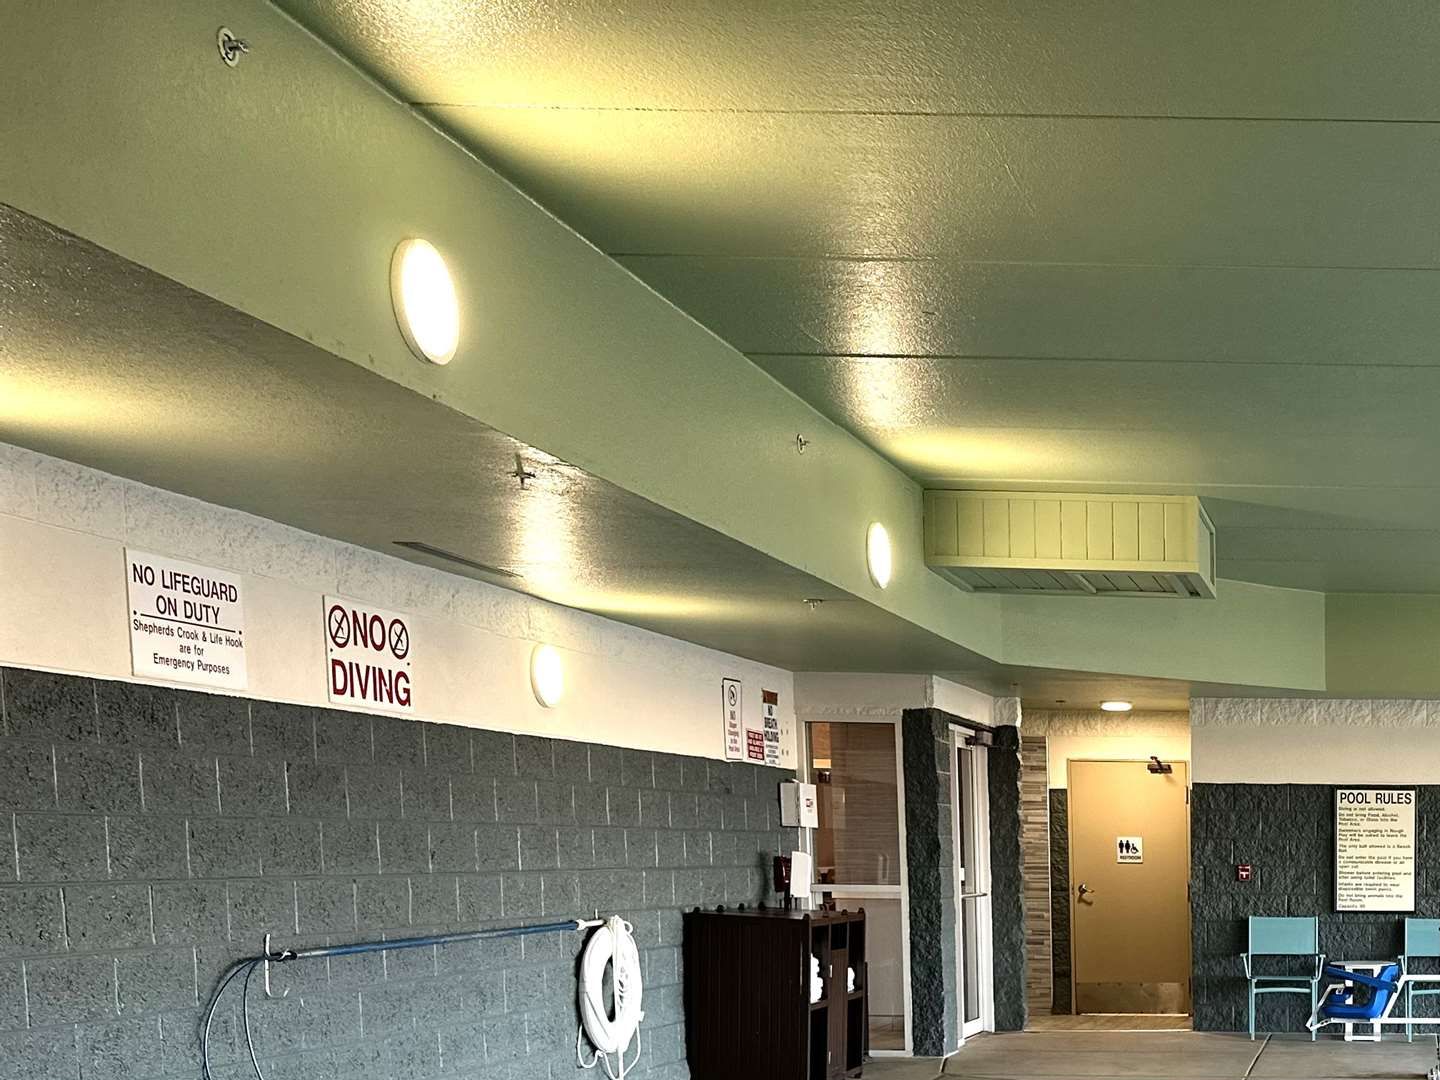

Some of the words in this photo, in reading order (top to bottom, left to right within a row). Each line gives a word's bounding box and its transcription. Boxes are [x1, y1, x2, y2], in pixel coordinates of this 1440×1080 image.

[132, 563, 155, 586] NO
[161, 569, 238, 603] LIFEGUARD
[156, 595, 178, 615] ON
[184, 600, 220, 625] DUTY
[133, 618, 175, 637] Shepherds
[177, 626, 199, 642] Crook
[201, 632, 207, 643] &
[209, 632, 223, 646] Life
[225, 635, 244, 649] Hook
[351, 610, 386, 651] NO
[153, 652, 195, 672] Emergency
[197, 659, 230, 676] Purposes
[179, 645, 191, 655] are
[193, 644, 204, 657] for
[331, 659, 411, 707] DIVING
[1340, 792, 1371, 804] POOL
[1375, 792, 1412, 804] RULES
